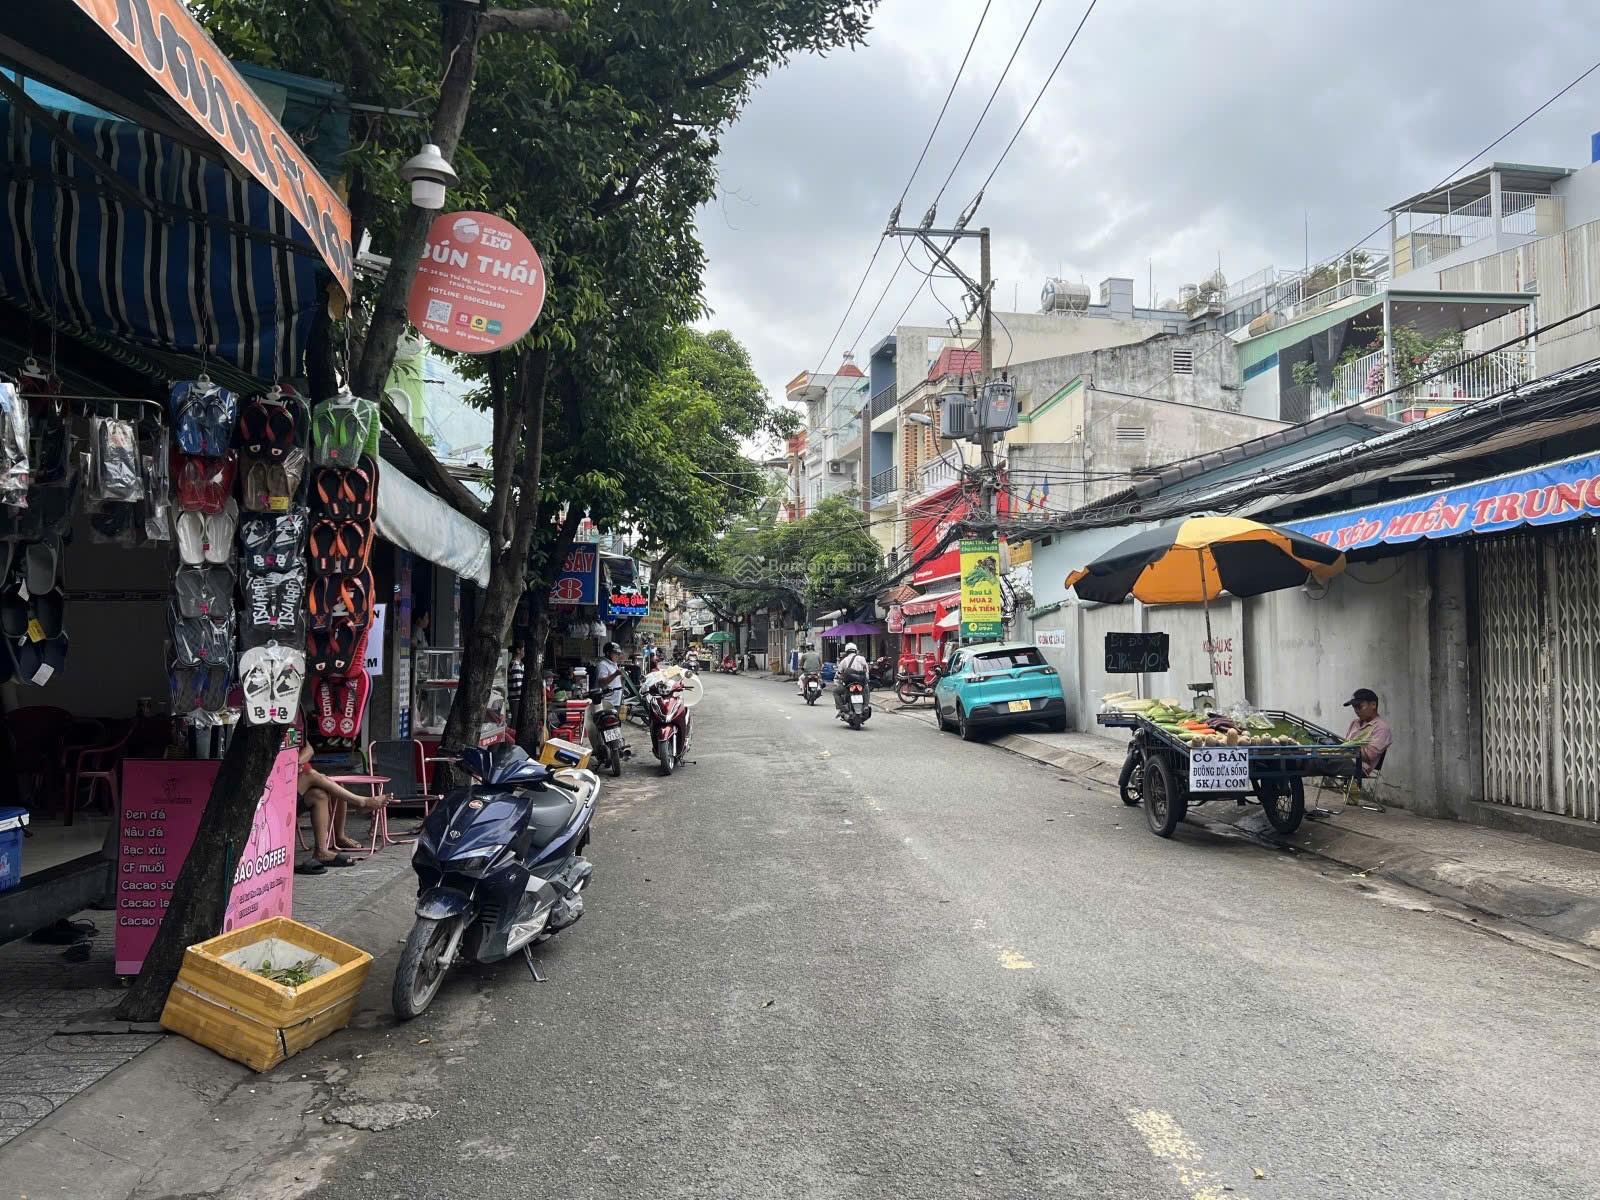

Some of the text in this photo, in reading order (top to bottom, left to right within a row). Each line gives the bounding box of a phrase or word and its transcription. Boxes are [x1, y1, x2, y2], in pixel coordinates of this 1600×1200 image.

[480, 233, 512, 251] LEO
[477, 255, 538, 286] THÁI
[422, 321, 449, 334] TikTok
[1193, 750, 1248, 762] CÓ BÁN
[1196, 779, 1246, 789] 5K/1 CON
[126, 809, 166, 819] Đen đá
[124, 826, 163, 837] Nâu đá
[123, 845, 143, 856] Bạc
[123, 860, 165, 873] CF muối
[255, 847, 287, 875] COFFEE
[122, 880, 175, 890] Cacao sữ
[121, 899, 156, 908] Cacao
[120, 916, 155, 926] Cacao
